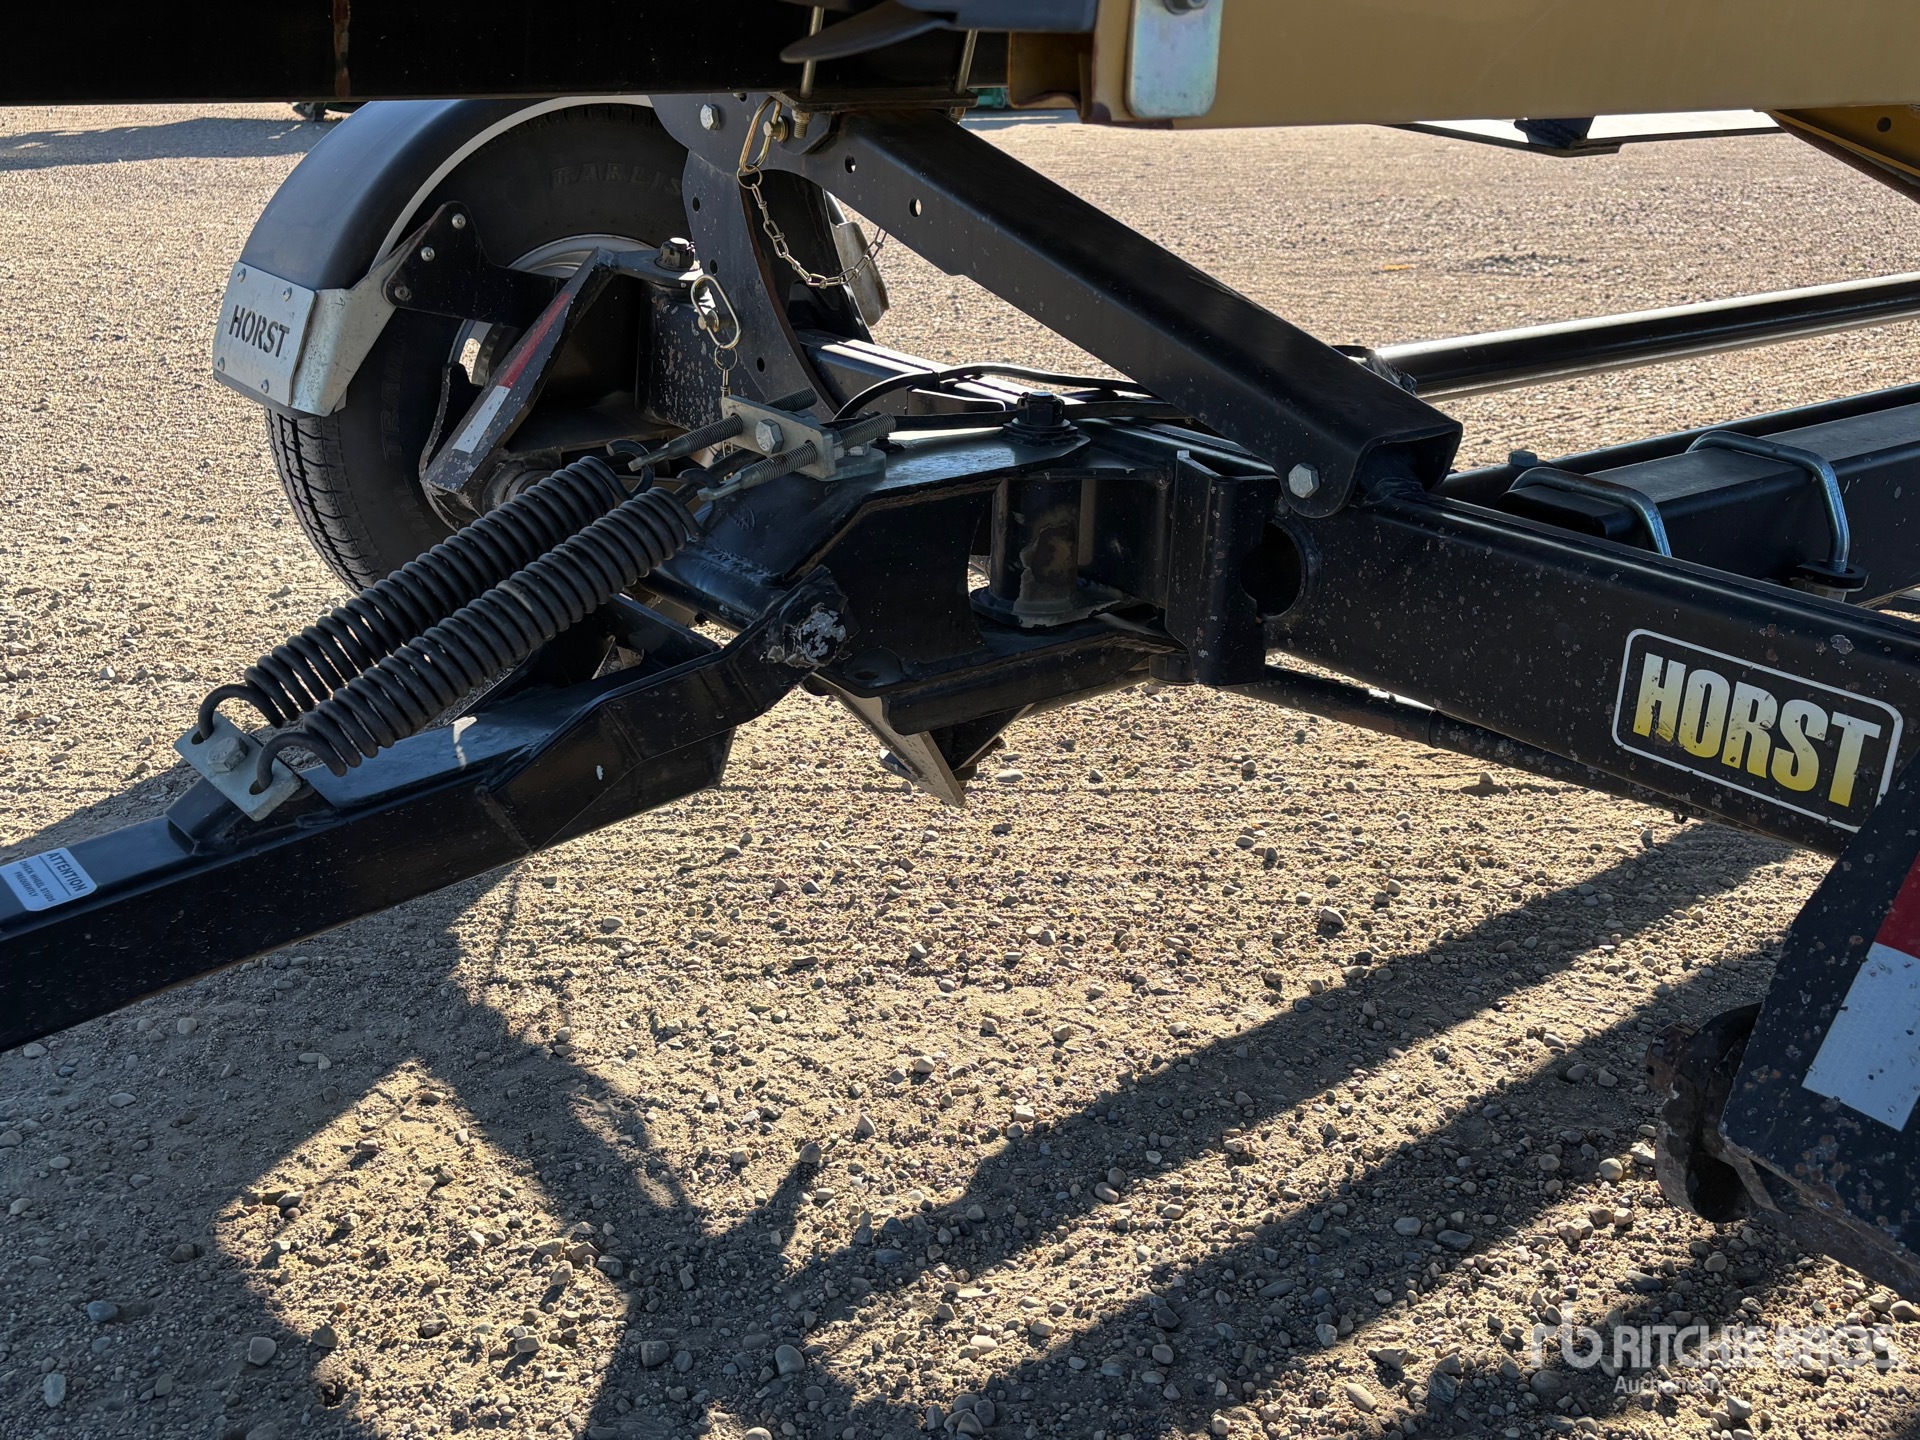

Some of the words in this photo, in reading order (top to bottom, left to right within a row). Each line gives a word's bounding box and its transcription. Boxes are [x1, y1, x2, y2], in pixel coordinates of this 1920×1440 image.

[229, 305, 290, 357] HORST
[1632, 652, 1881, 807] HORST
[19, 860, 33, 875] CHECK
[47, 852, 88, 892] ATTENTION
